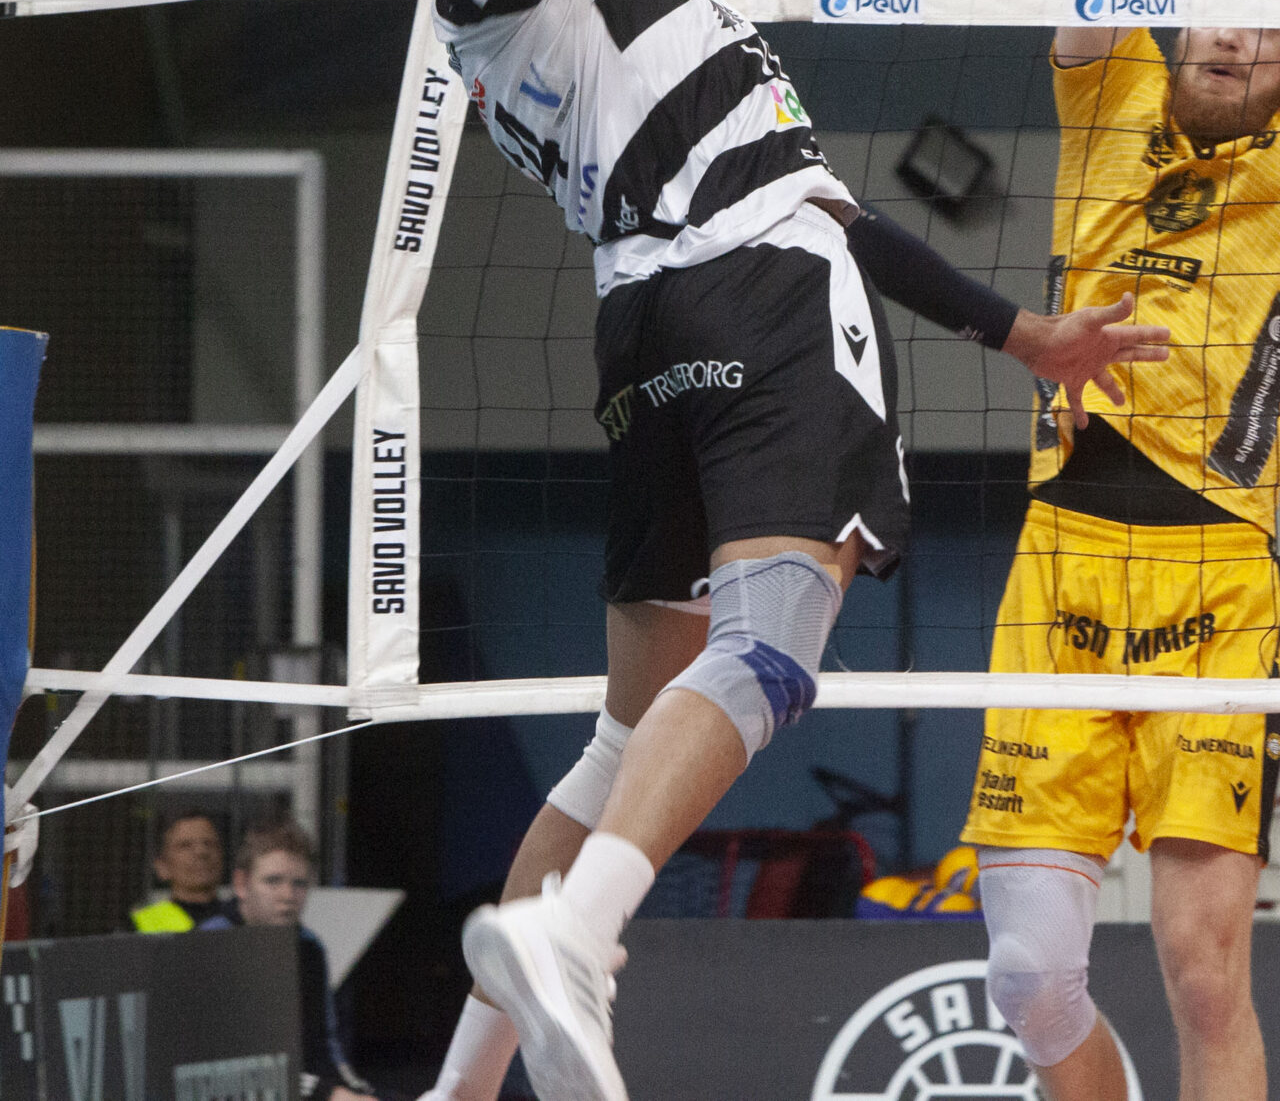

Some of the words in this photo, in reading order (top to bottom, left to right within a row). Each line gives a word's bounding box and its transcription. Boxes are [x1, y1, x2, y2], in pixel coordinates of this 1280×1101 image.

[393, 180, 435, 254] SAVO
[373, 428, 406, 533] VOLLEY
[373, 543, 405, 615] SAVO
